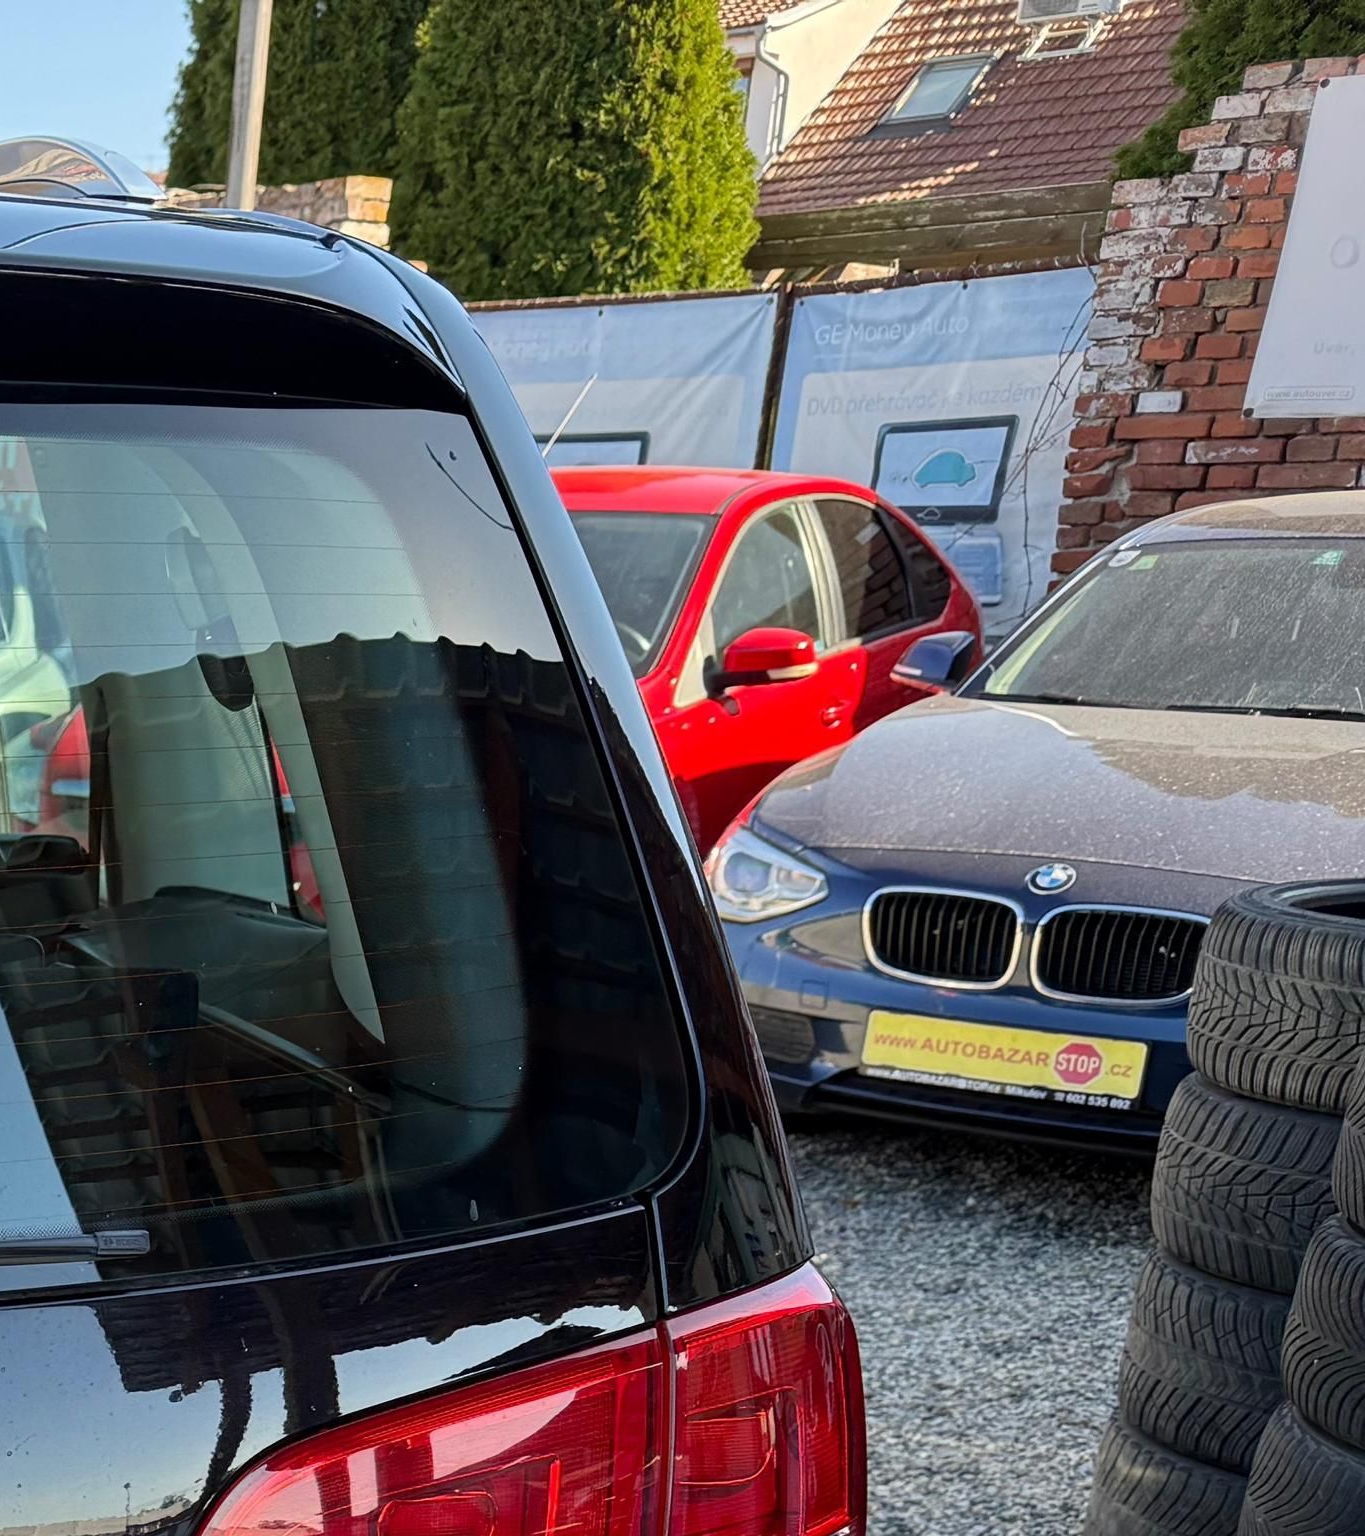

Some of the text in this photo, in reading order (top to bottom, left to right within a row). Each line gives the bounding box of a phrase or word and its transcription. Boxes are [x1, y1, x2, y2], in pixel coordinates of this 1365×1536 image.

[814, 314, 970, 346] GE Money Auto
[1055, 1052, 1101, 1075] STOP
